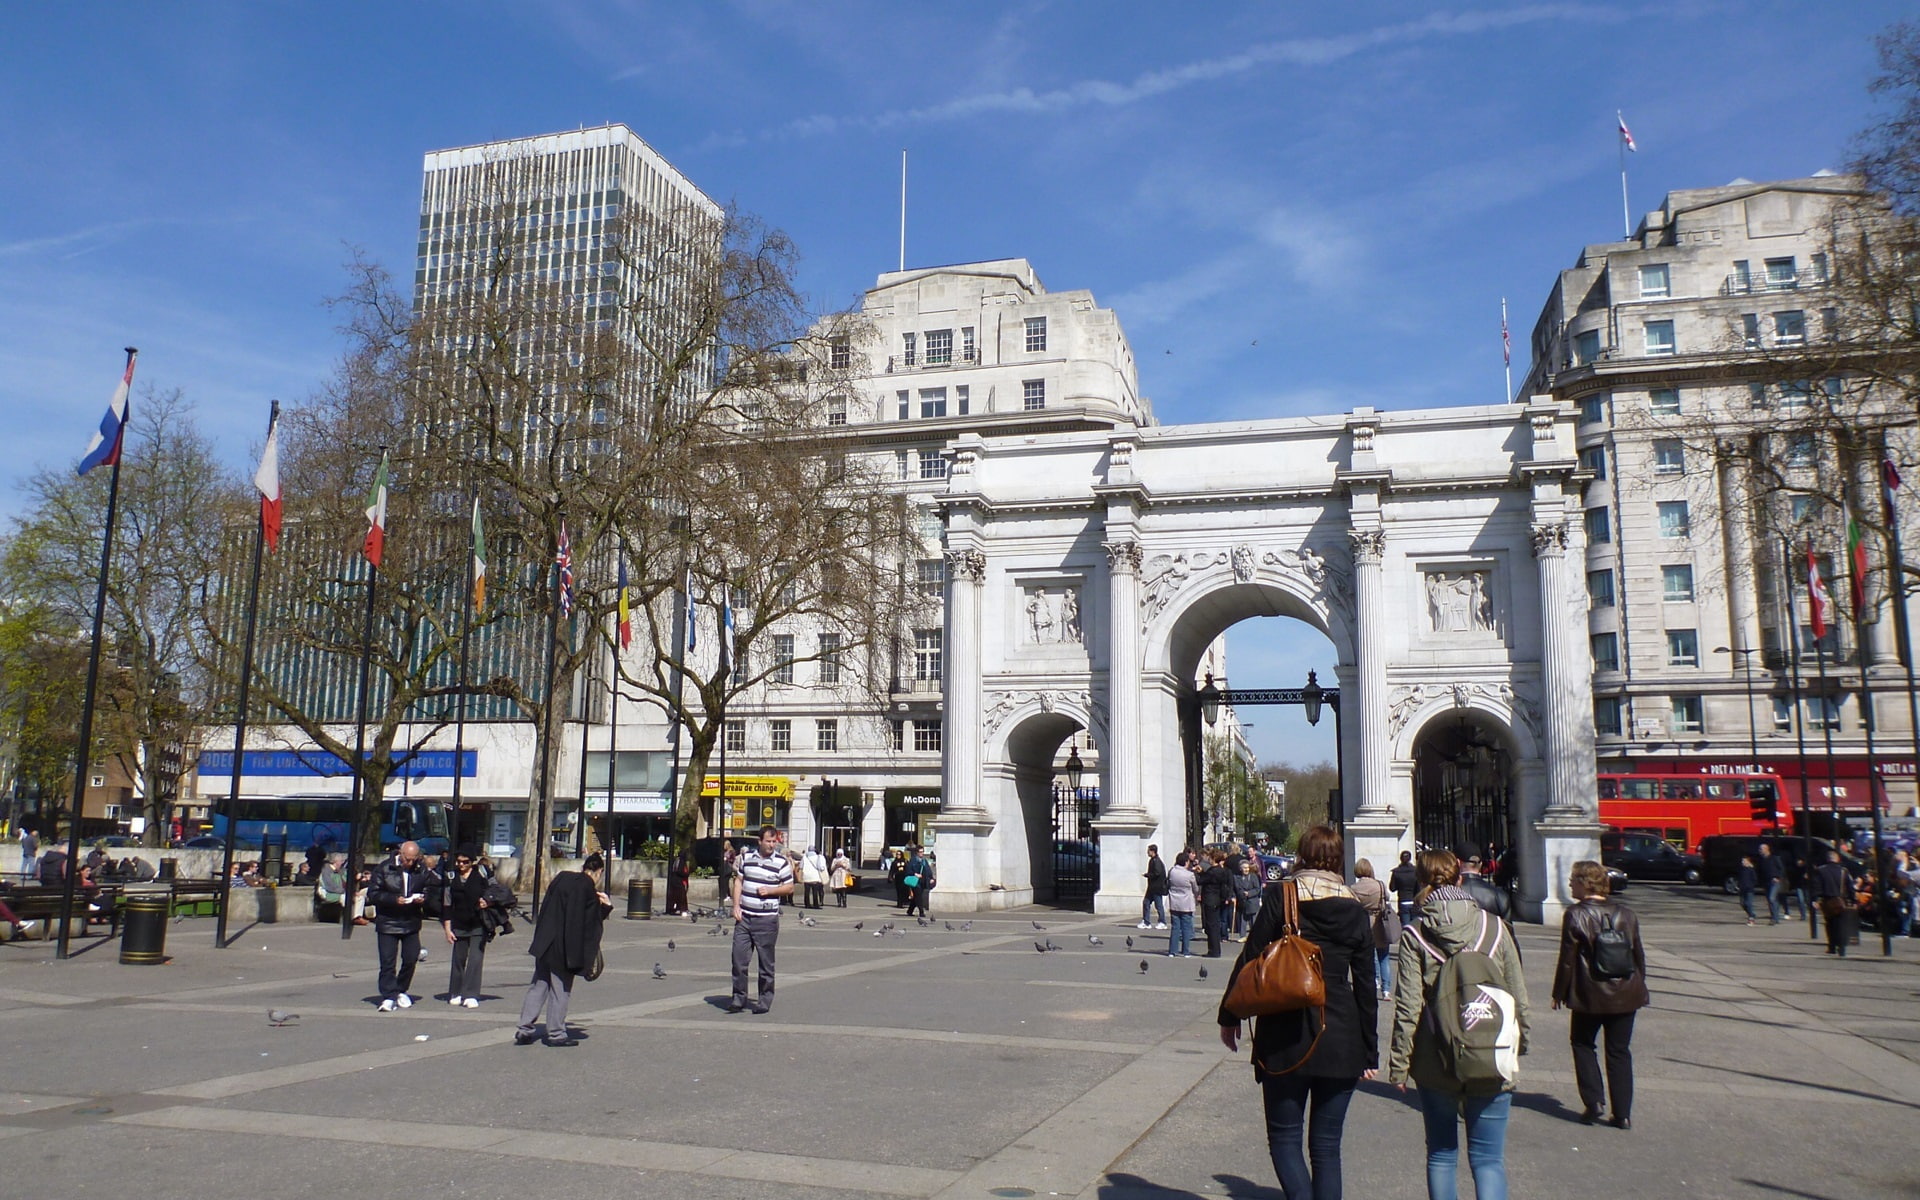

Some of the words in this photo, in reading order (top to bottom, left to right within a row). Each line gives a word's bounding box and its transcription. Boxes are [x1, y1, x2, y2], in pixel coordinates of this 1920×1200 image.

[252, 757, 274, 768] FILM
[276, 757, 297, 768] LINE
[323, 757, 336, 768] 22
[1710, 764, 1728, 775] PRET
[1729, 765, 1734, 774] A
[1735, 764, 1763, 774] MANGR
[1882, 763, 1901, 773] PRET
[1902, 764, 1908, 773] A
[724, 784, 743, 792] ureau
[744, 783, 753, 792] de
[754, 783, 778, 793] change
